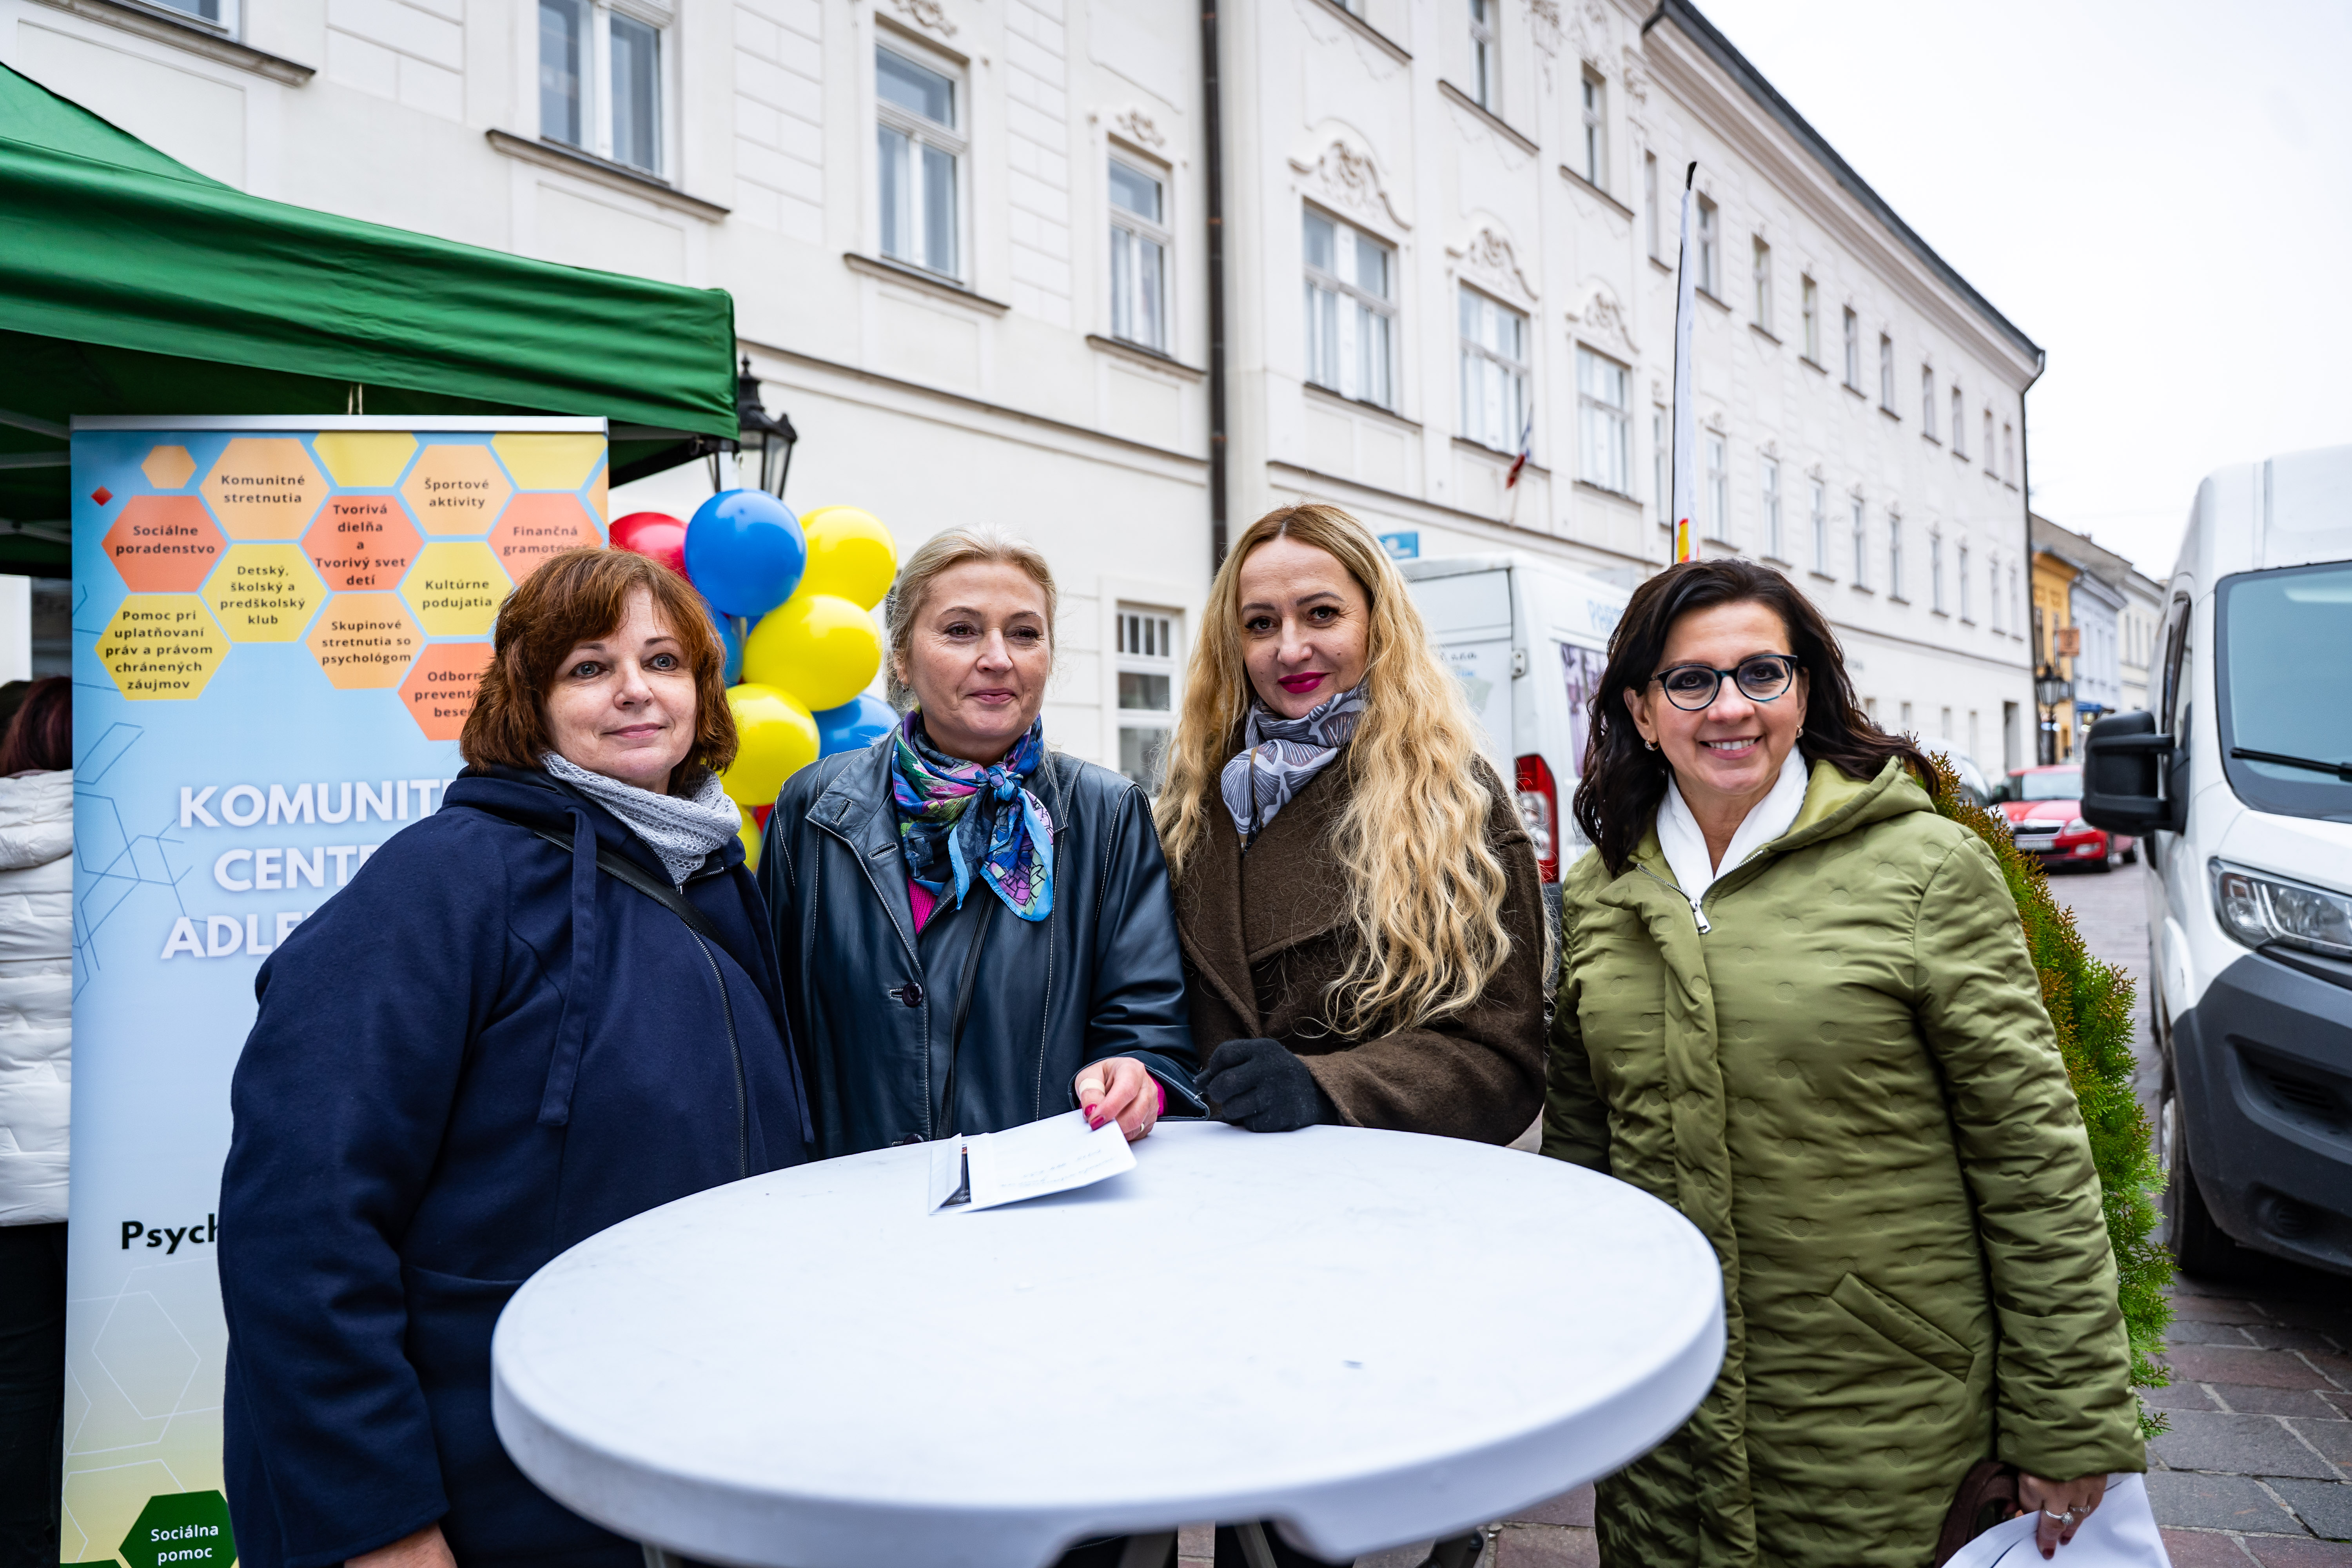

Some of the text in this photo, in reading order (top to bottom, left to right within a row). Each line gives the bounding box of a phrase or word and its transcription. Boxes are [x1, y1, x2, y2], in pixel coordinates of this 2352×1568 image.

[221, 475, 305, 486] Komunitné
[425, 477, 489, 491] Športové
[224, 492, 302, 503] stretnutia
[429, 496, 485, 509] aktivity
[333, 504, 387, 515] Tvorivá
[133, 524, 198, 536] Sociálne
[338, 521, 383, 533] dielňa
[513, 526, 578, 537] Finančná
[115, 543, 216, 556] poradenstvo
[356, 541, 365, 550] a
[315, 557, 405, 570] Tvorivý svet
[237, 565, 289, 578] Detský,
[346, 575, 375, 586] detí
[425, 579, 490, 590] Kultúrne
[230, 582, 283, 594] školský
[220, 598, 305, 611] predškolský
[422, 596, 492, 611] podujatia
[122, 610, 196, 623] Pomoc pri
[248, 614, 278, 625] klub
[331, 620, 402, 632] Skupinové
[114, 627, 204, 641] uplatňovaní
[322, 637, 411, 647] stretnutia so
[105, 645, 213, 658] práv a právom
[322, 653, 411, 666] psychológom
[114, 661, 202, 675] chránených
[127, 679, 190, 692] záujmov
[180, 778, 454, 828] KOMUNIT
[161, 911, 315, 960] ADLE
[151, 1524, 219, 1542] Sociálna
[158, 1548, 212, 1566] pomoc
